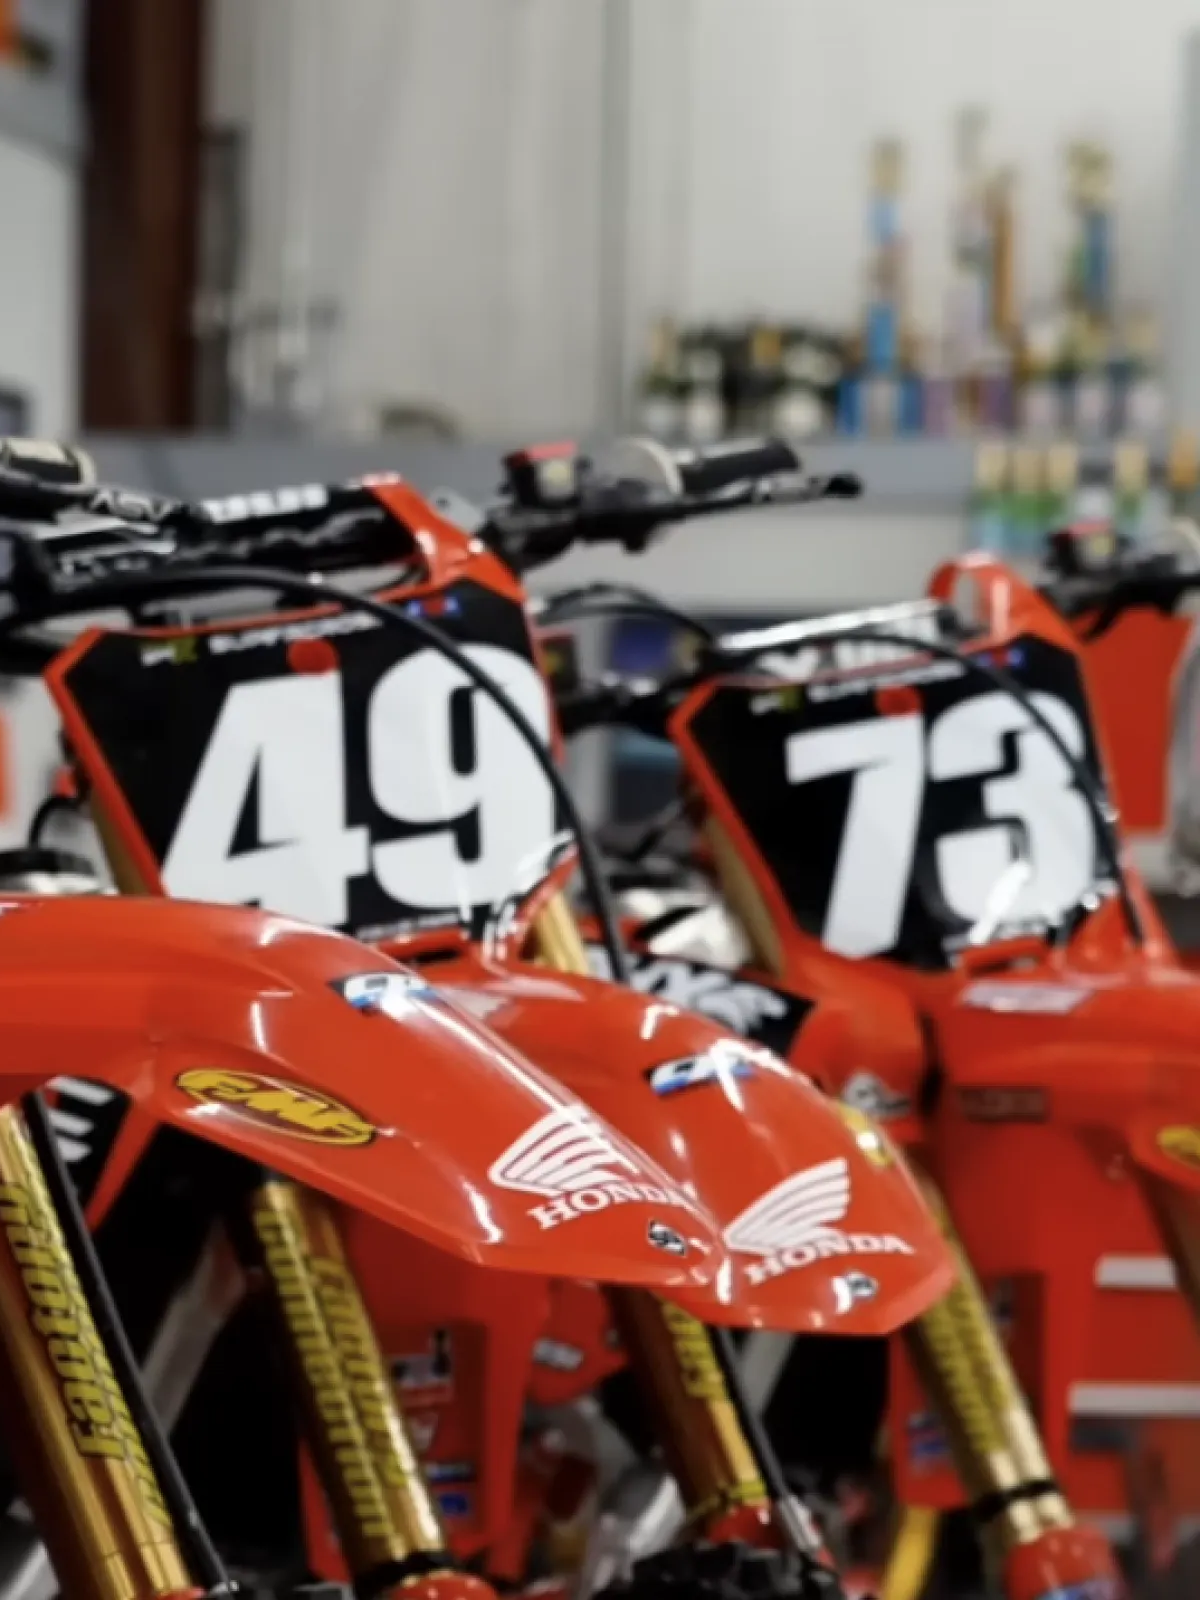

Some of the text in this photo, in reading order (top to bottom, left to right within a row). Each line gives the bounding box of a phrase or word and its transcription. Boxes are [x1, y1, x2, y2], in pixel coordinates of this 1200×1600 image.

[161, 643, 556, 925] 49
[785, 690, 1098, 960] 73
[746, 1234, 916, 1286] HONDA
